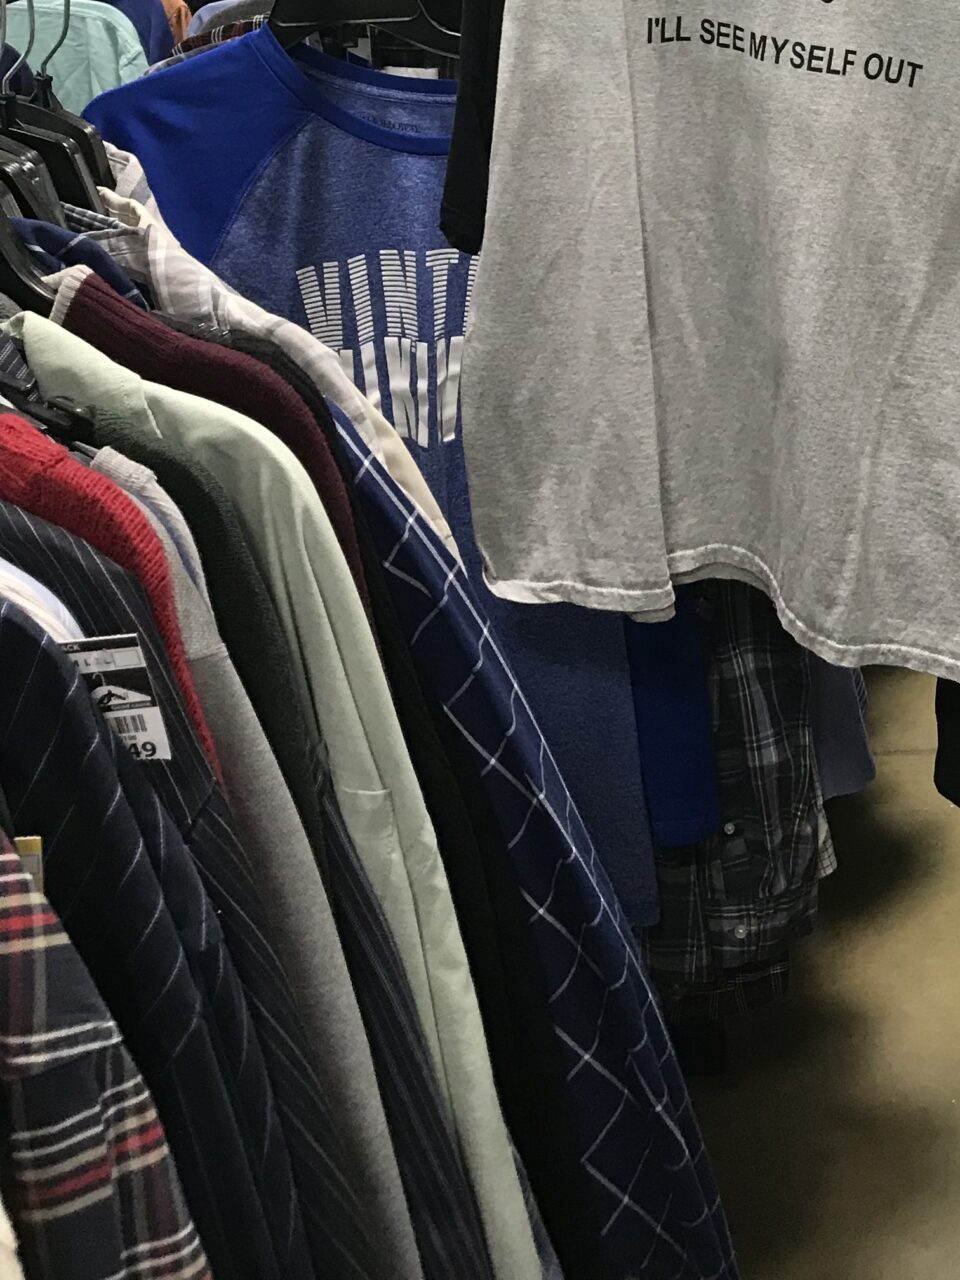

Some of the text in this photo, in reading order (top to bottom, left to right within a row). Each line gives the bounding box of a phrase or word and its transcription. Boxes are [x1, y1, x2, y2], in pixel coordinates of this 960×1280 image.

[646, 15, 924, 88] I'LL SEE MYSELF OUT
[295, 248, 479, 352] VINT
